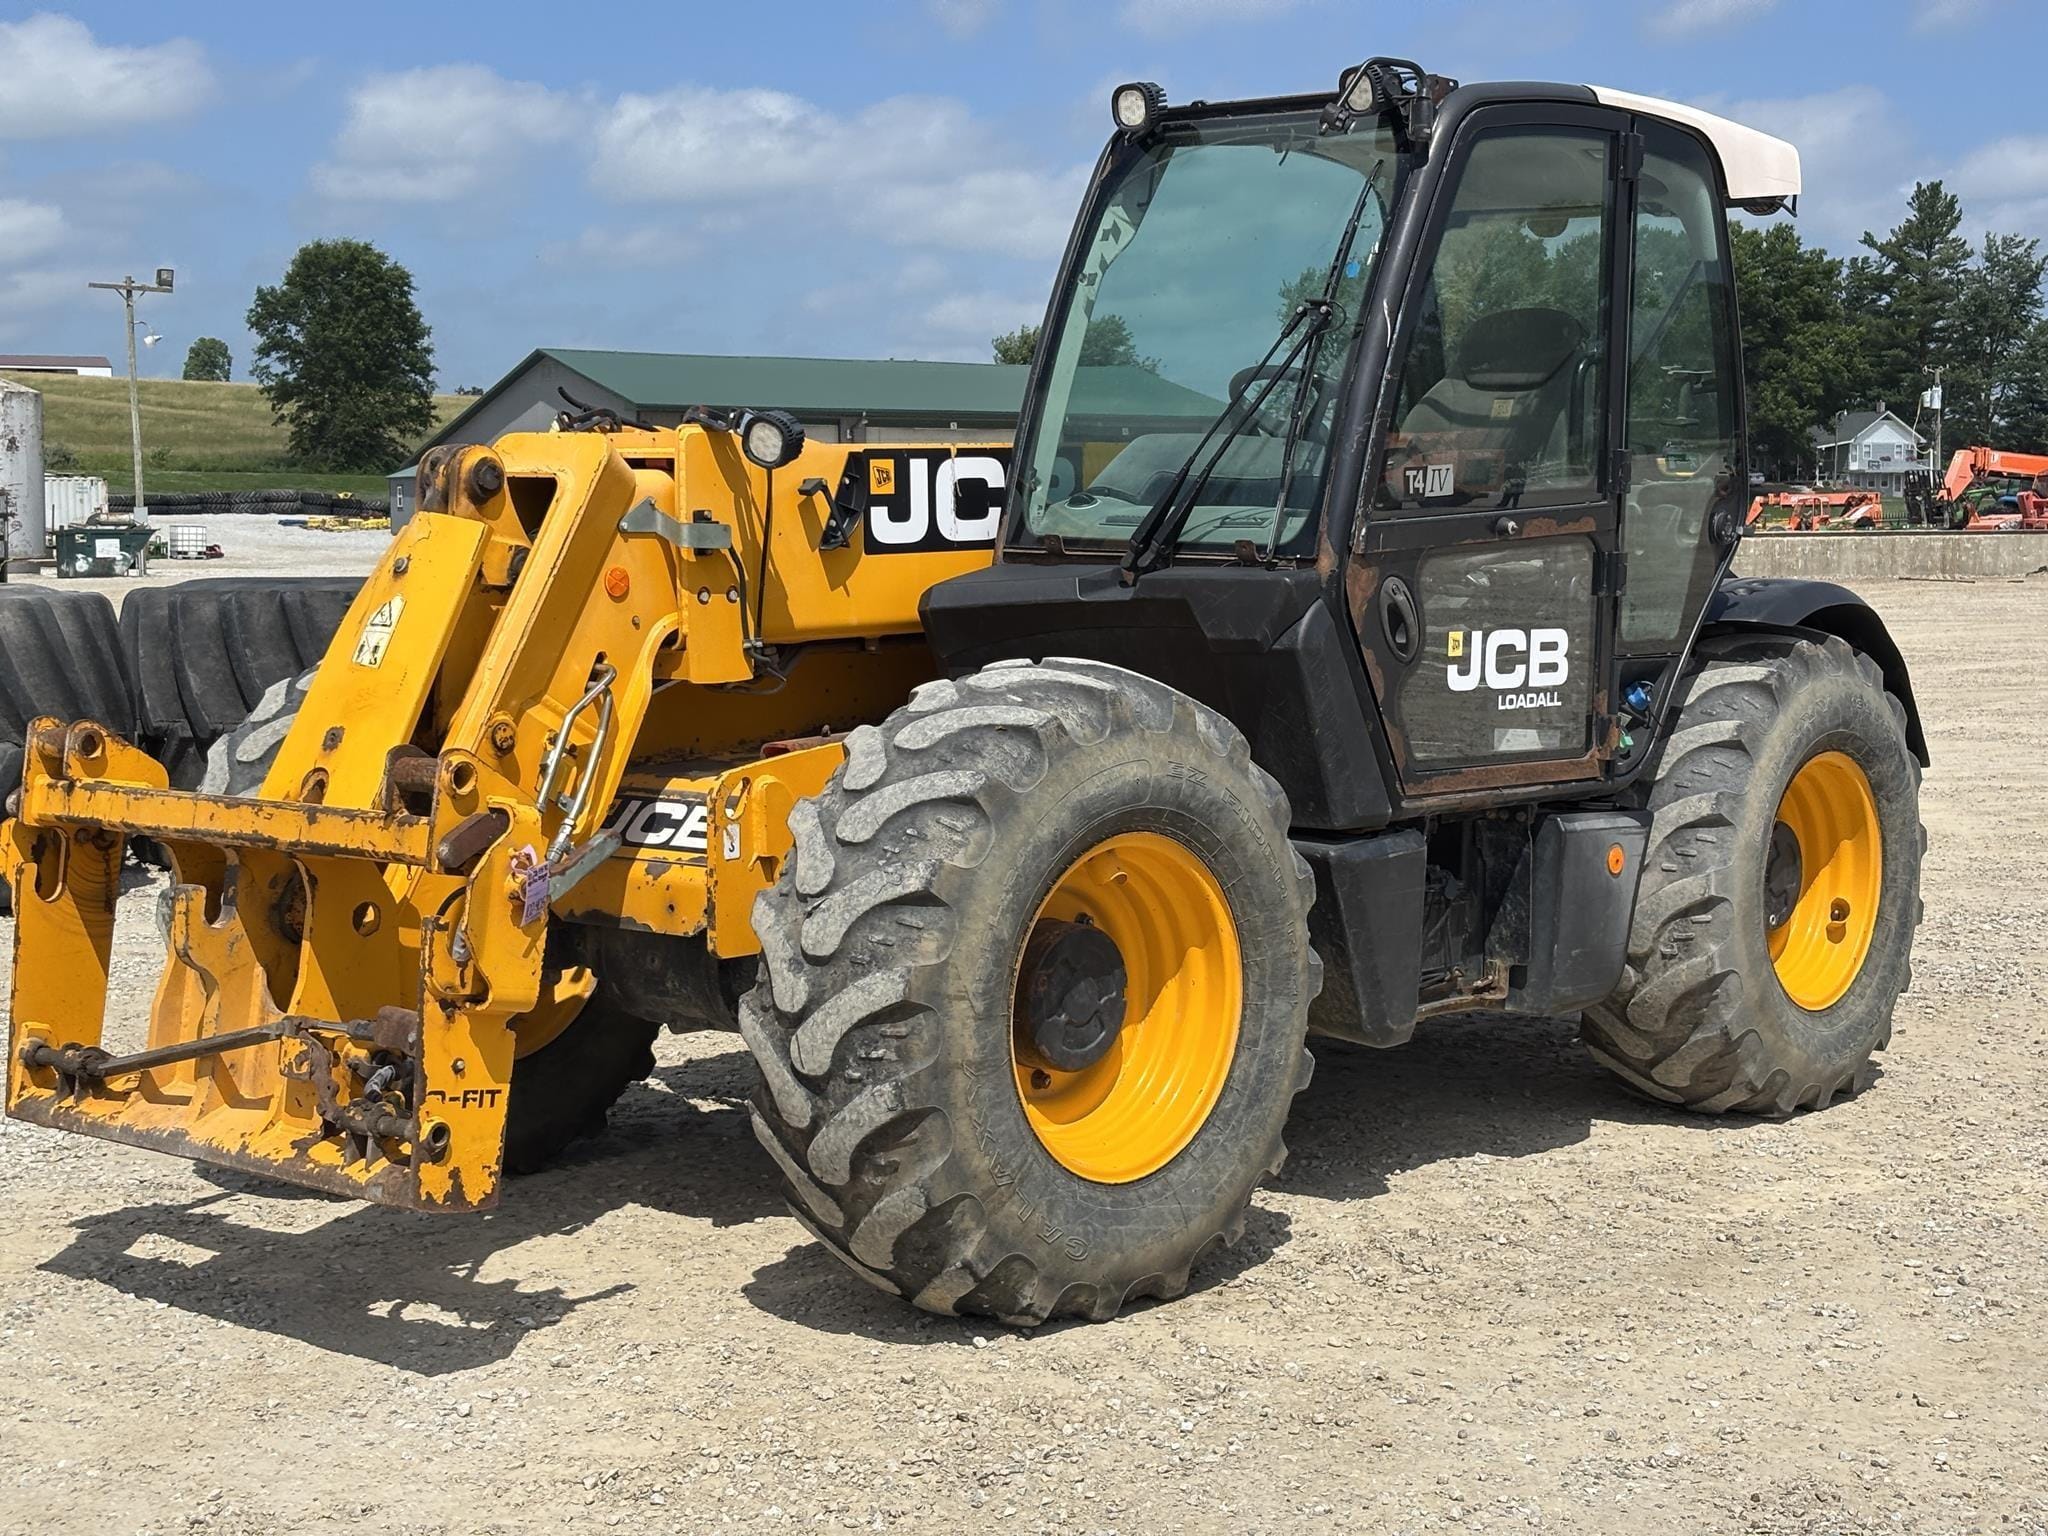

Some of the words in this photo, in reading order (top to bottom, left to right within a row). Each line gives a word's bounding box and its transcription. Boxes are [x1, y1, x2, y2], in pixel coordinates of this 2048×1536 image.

[1405, 469, 1424, 494] T4
[1429, 468, 1450, 493] IV
[1446, 628, 1569, 691] JCB
[1498, 691, 1562, 710] LOADALL
